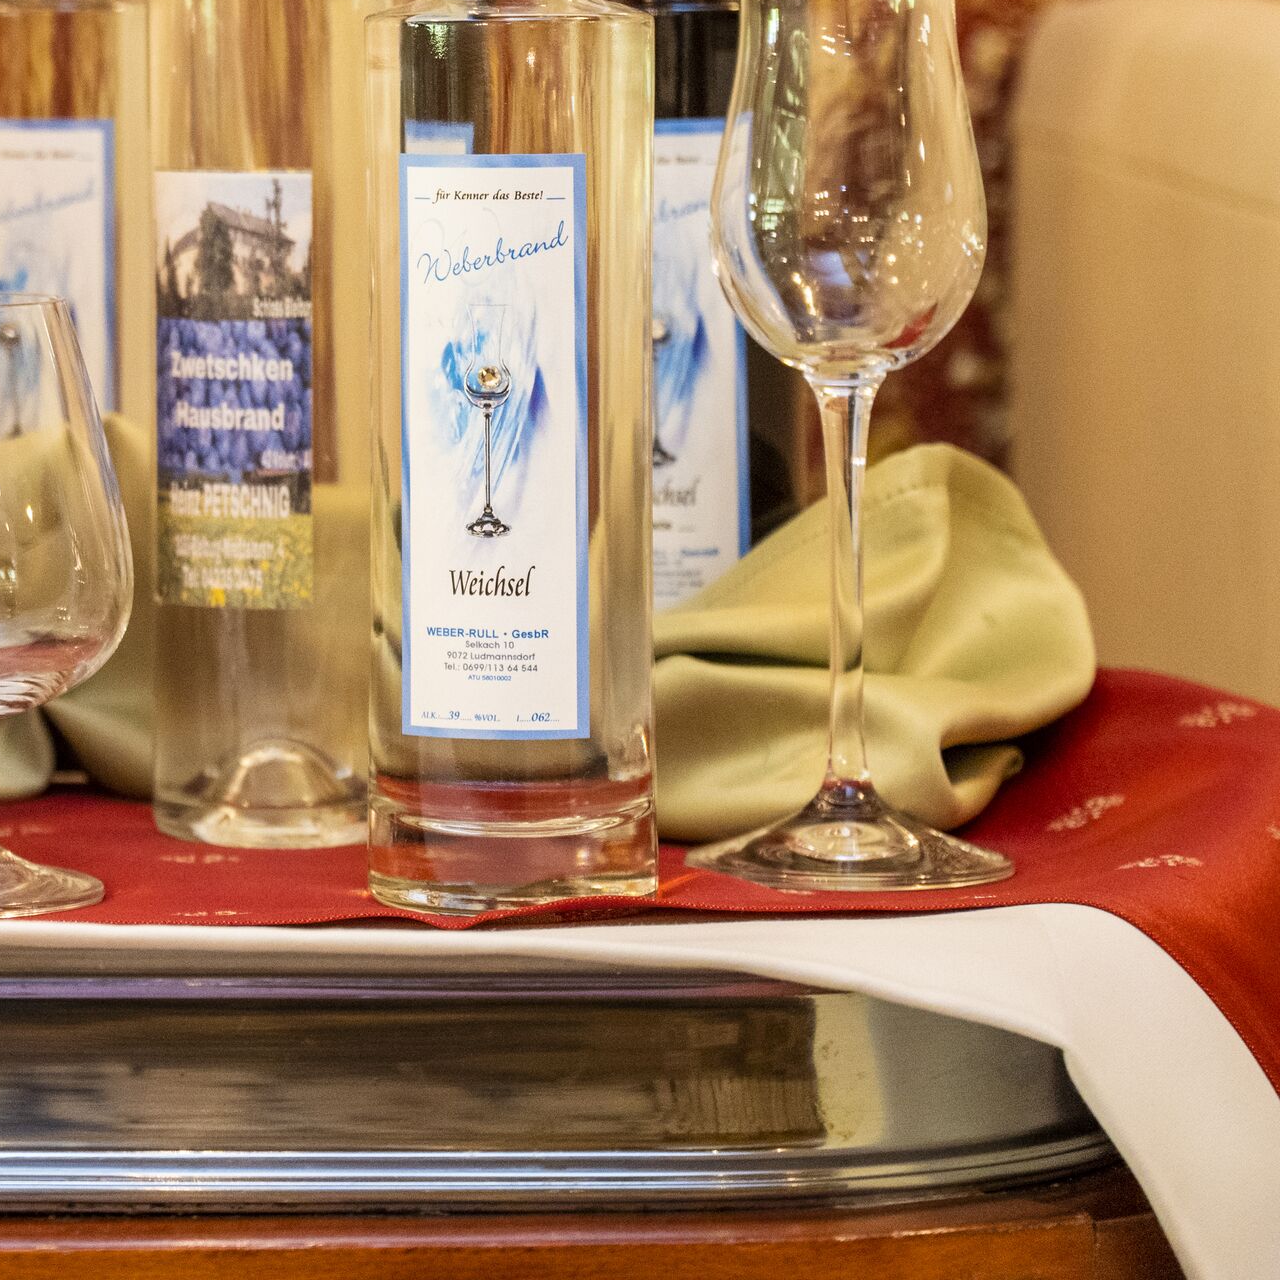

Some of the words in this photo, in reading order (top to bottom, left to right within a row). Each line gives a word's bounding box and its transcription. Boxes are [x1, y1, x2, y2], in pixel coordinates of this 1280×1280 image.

[432, 189, 450, 204] für
[454, 190, 490, 200] Kenner
[492, 189, 510, 200] das
[514, 190, 544, 200] Beste!
[417, 220, 569, 284] Weberbrand
[171, 350, 293, 381] Zwetschken
[176, 401, 285, 431] Hausbrand
[203, 483, 290, 518] PETSCHNIG
[449, 566, 536, 597] Weichsel
[427, 627, 499, 639] WEBER-RULL
[512, 629, 549, 639] GesbR
[465, 640, 500, 649] Selkach
[504, 641, 515, 649] 10
[447, 651, 468, 660] 9072
[470, 652, 535, 661] Ludmannsdorf
[444, 663, 460, 671] Tel.:
[463, 663, 504, 672] 0699/113
[507, 664, 519, 672] 64
[522, 664, 538, 672] 544
[449, 711, 460, 720] 39
[531, 712, 550, 722] 062
